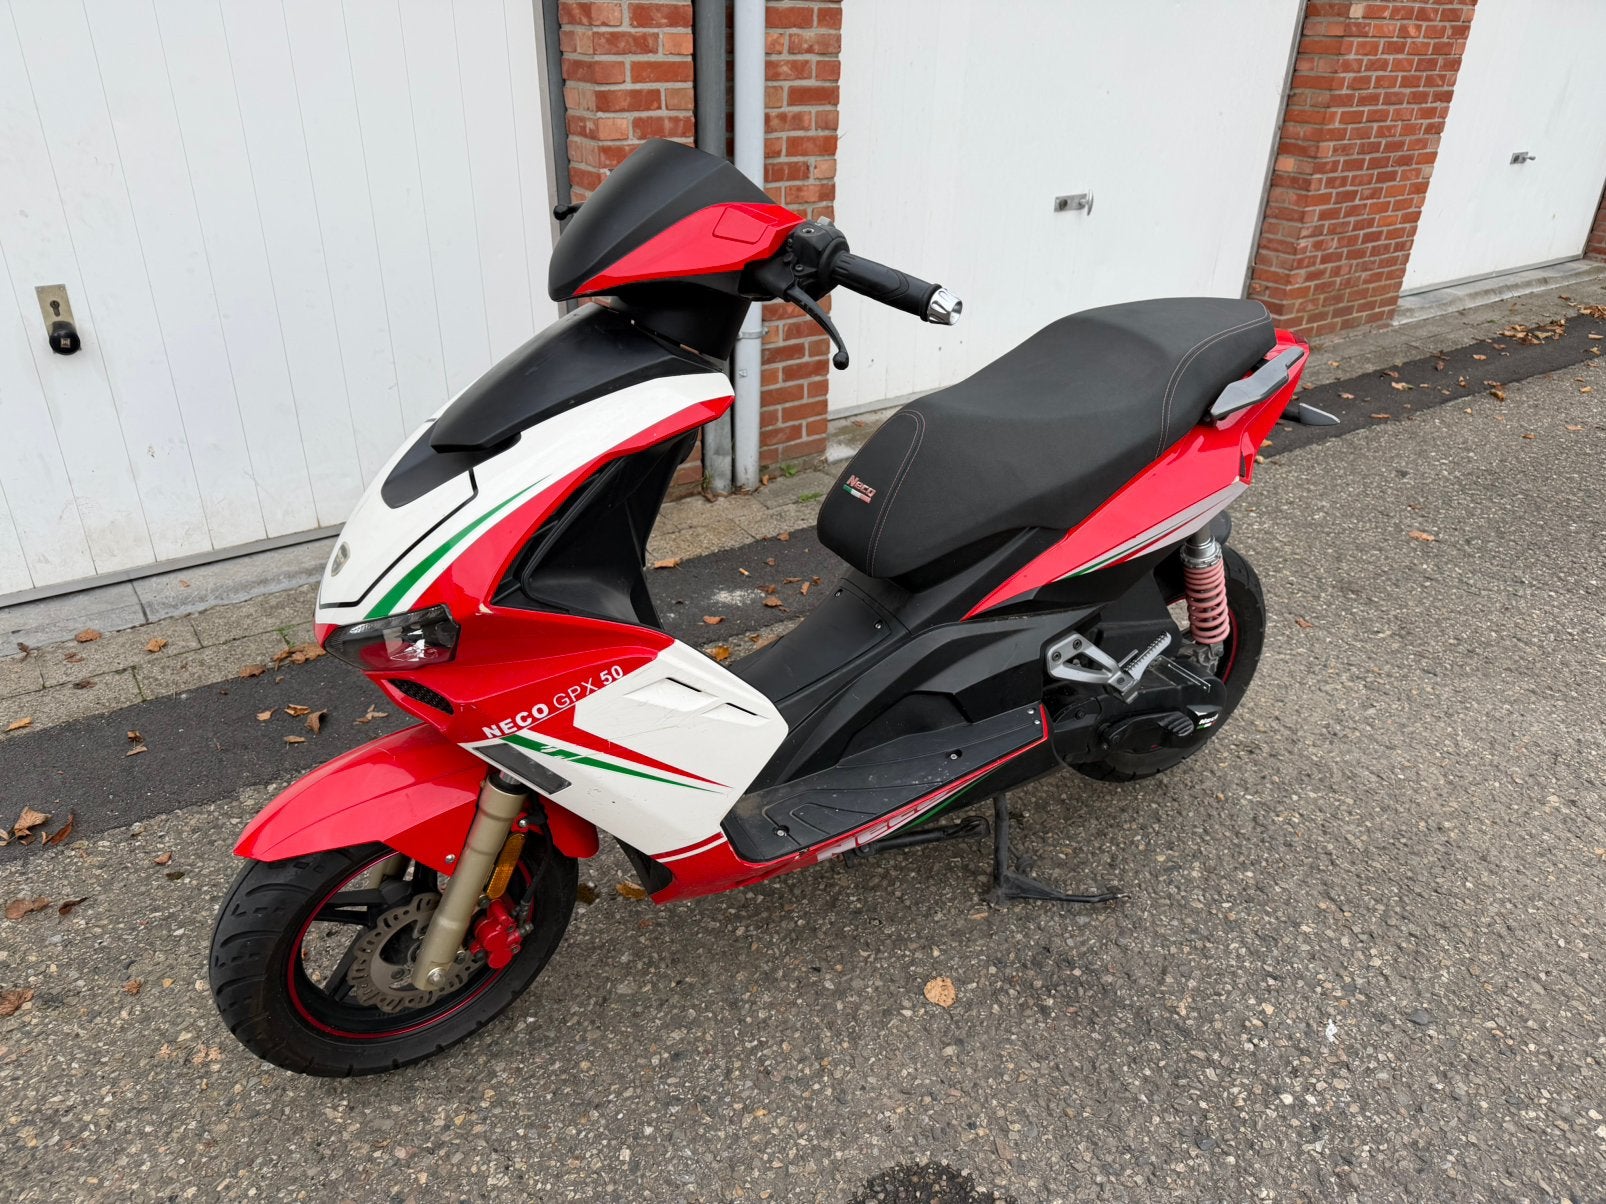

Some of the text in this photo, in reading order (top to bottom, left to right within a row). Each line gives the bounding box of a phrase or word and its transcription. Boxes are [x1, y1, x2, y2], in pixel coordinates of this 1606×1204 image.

[481, 665, 624, 739] NECO GPX 50
